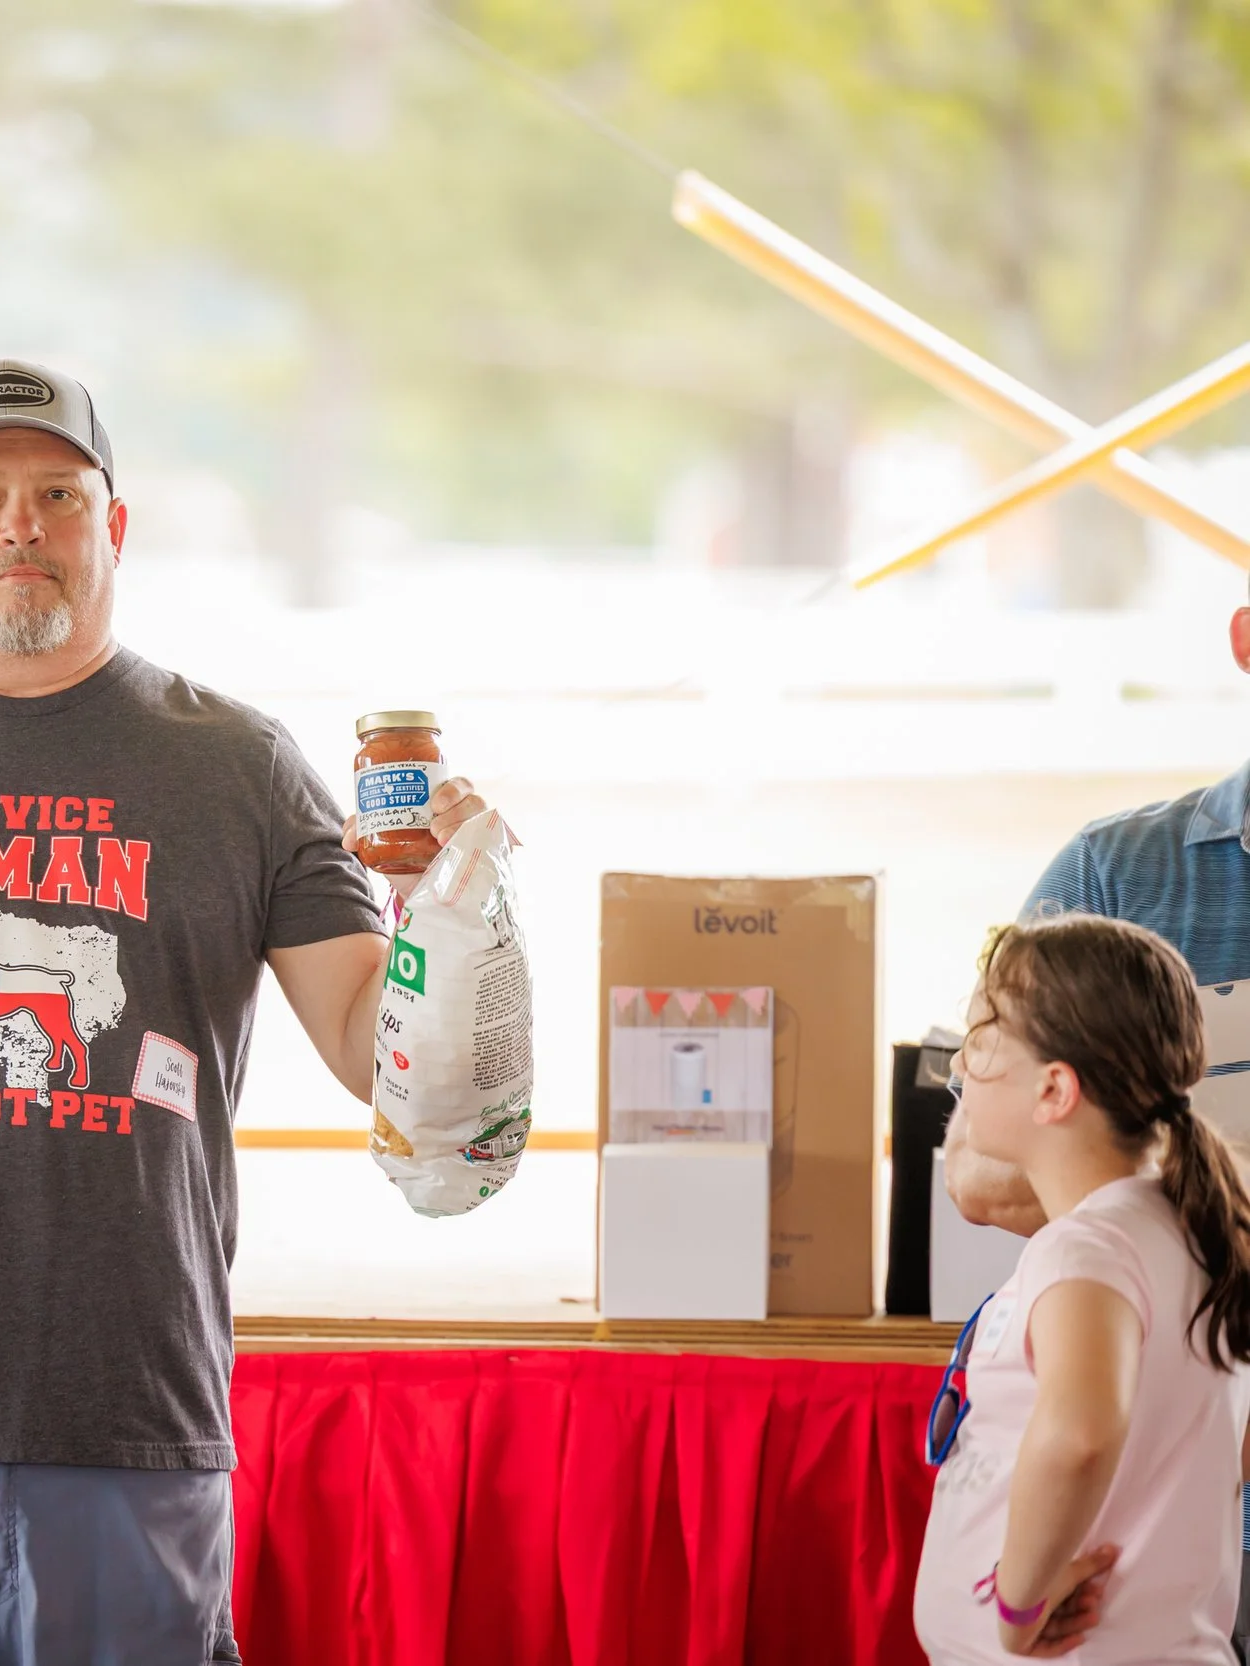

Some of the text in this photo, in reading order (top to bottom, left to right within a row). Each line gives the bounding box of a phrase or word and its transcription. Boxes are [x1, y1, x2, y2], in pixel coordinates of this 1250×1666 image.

[365, 772, 414, 787] MARK'S
[366, 794, 417, 809] GOOD STUFF
[370, 818, 403, 830] SALSA
[392, 986, 415, 1004] 1954
[381, 1008, 403, 1034] ips
[49, 1094, 137, 1135] PET
